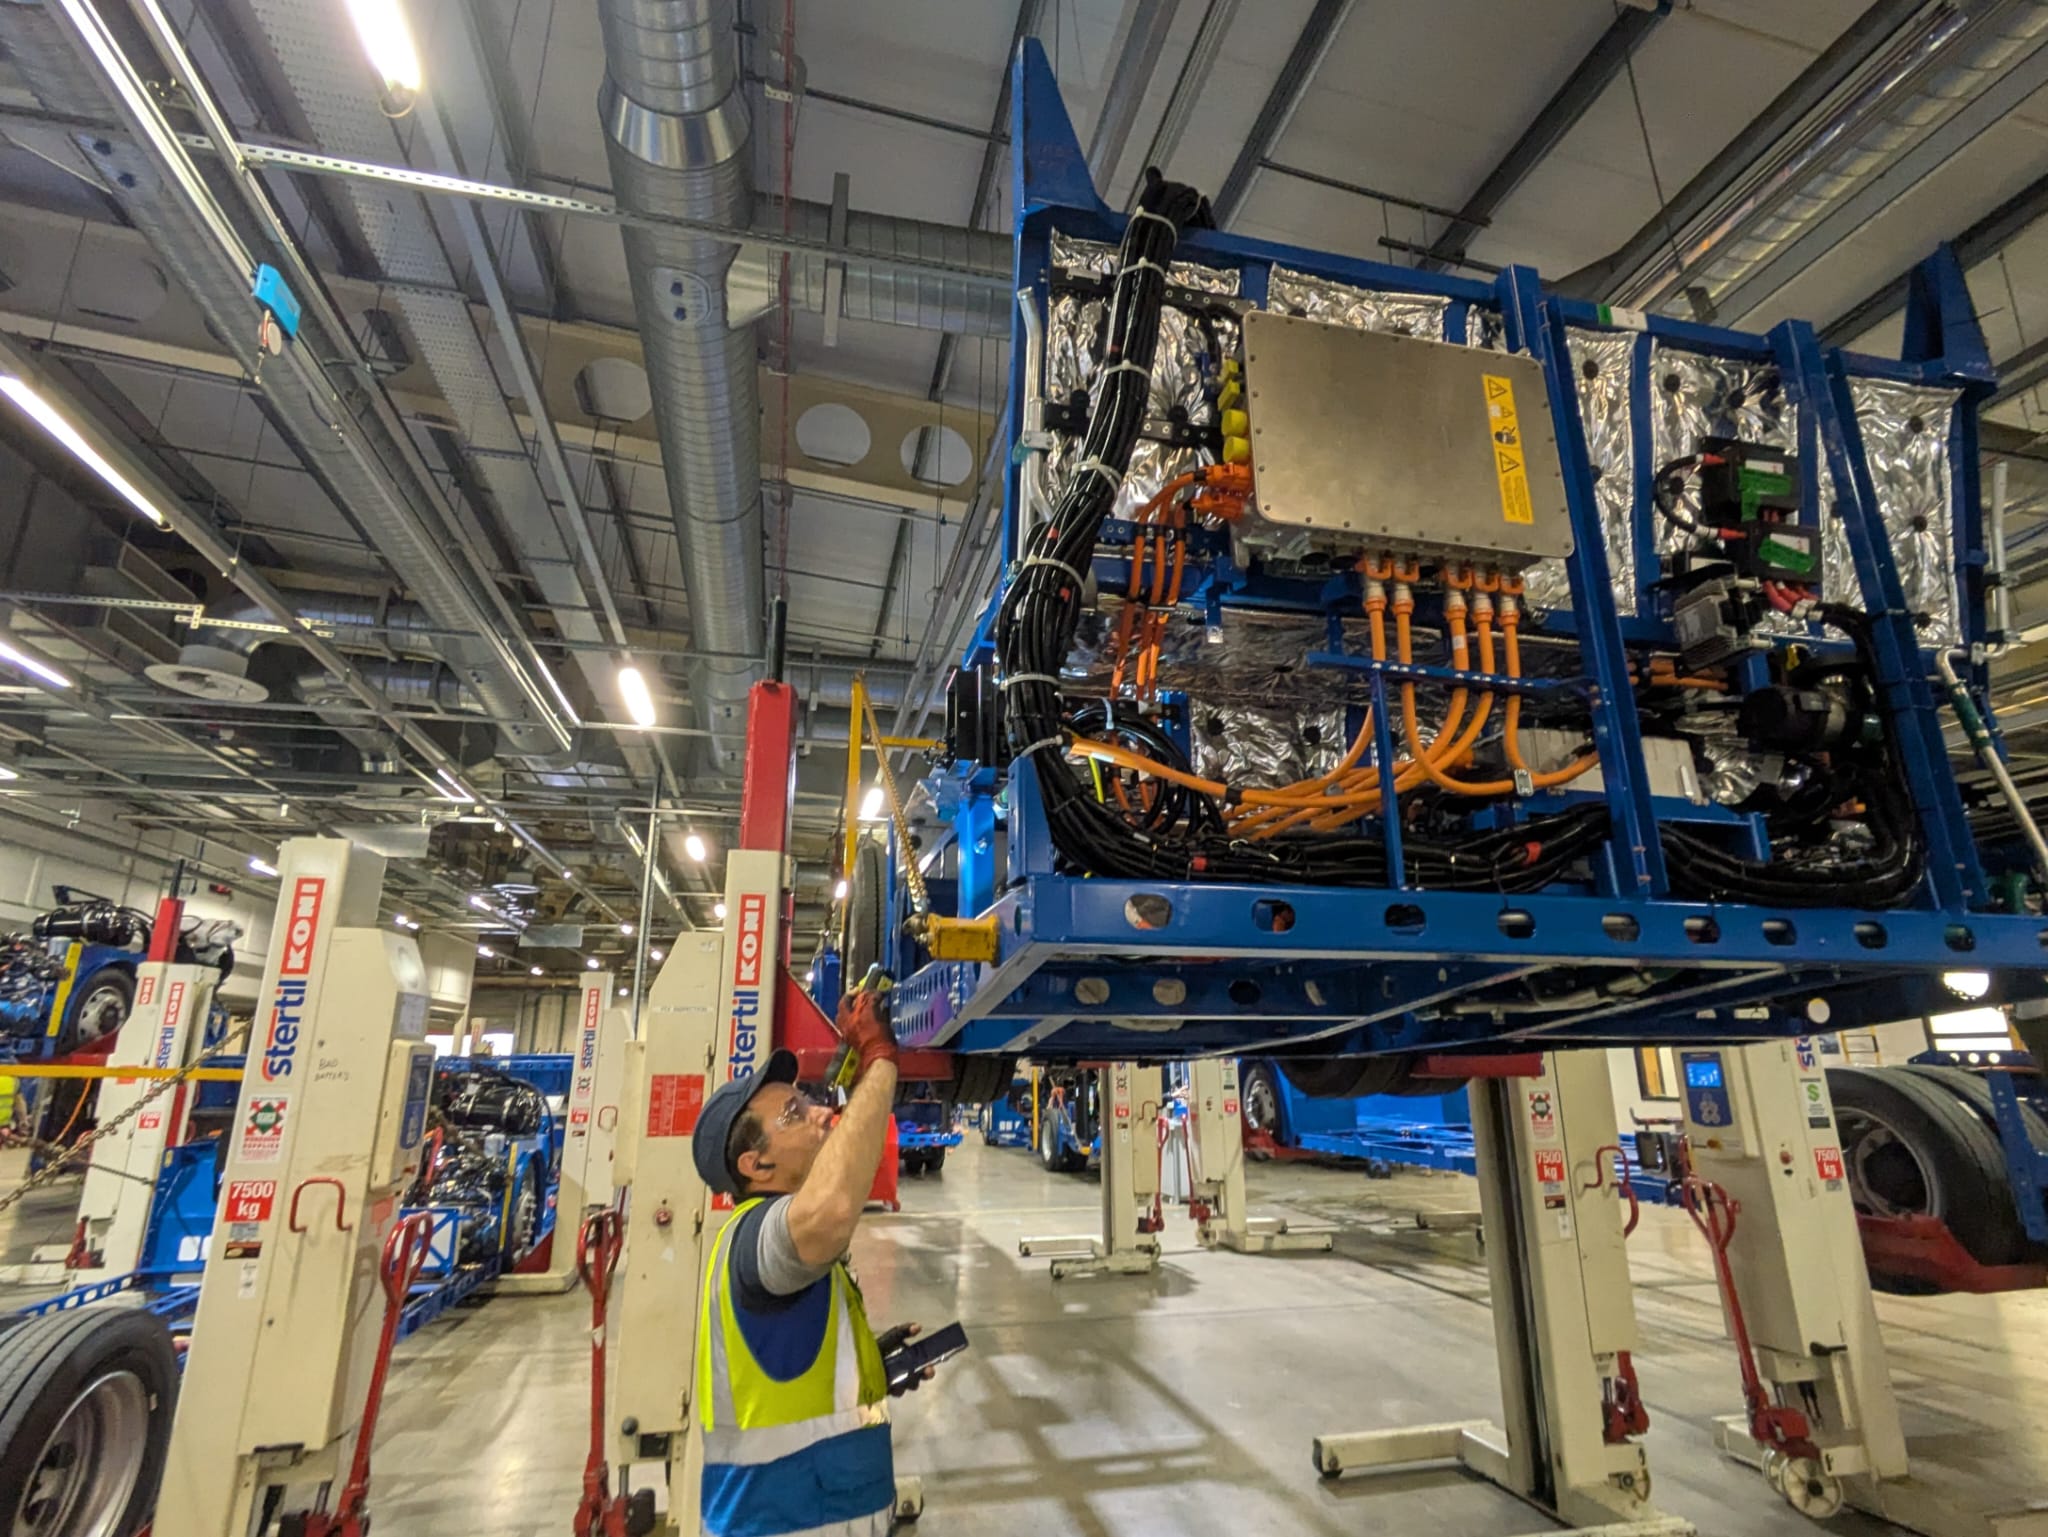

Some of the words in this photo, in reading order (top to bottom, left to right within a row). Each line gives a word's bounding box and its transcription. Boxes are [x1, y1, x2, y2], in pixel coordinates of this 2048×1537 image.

[740, 899, 761, 982] KONI
[262, 980, 307, 1082] stertil
[286, 883, 318, 970] KONI
[165, 984, 184, 1023] KONI
[587, 990, 599, 1026] KONI
[727, 990, 759, 1081] stertil
[580, 1030, 596, 1070] stertil
[1536, 1151, 1561, 1163] 7500
[1815, 1150, 1839, 1162] 7500
[1823, 1162, 1837, 1177] kg
[1543, 1165, 1557, 1180] kg
[231, 1181, 274, 1199] 7500
[237, 1199, 261, 1219] kg
